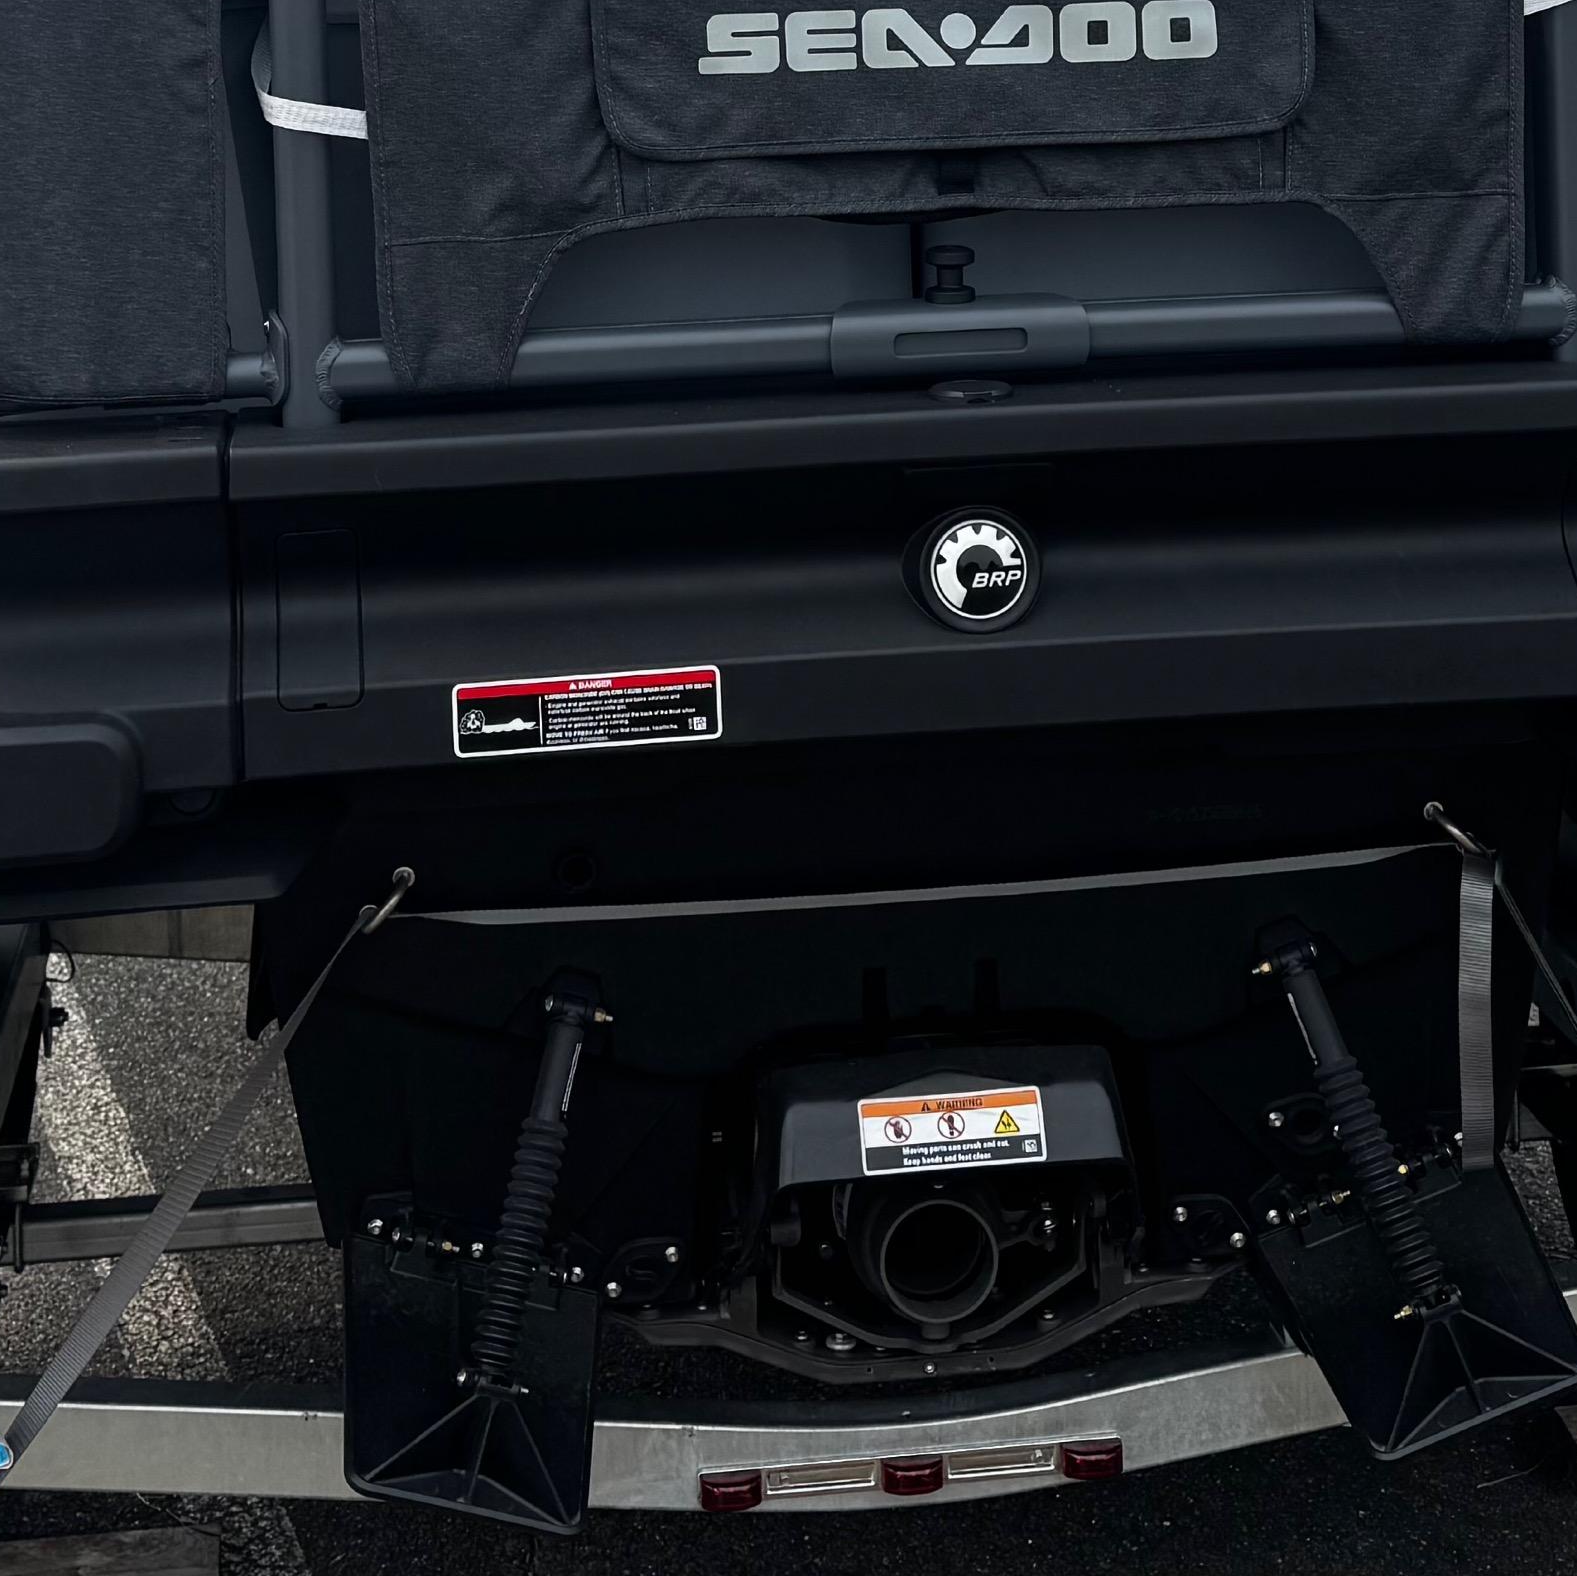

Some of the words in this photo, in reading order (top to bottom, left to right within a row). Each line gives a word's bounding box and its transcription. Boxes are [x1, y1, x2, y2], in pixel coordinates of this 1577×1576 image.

[971, 570, 1022, 589] BRP
[578, 680, 612, 691] DANGER
[936, 1098, 983, 1111] WARNING
